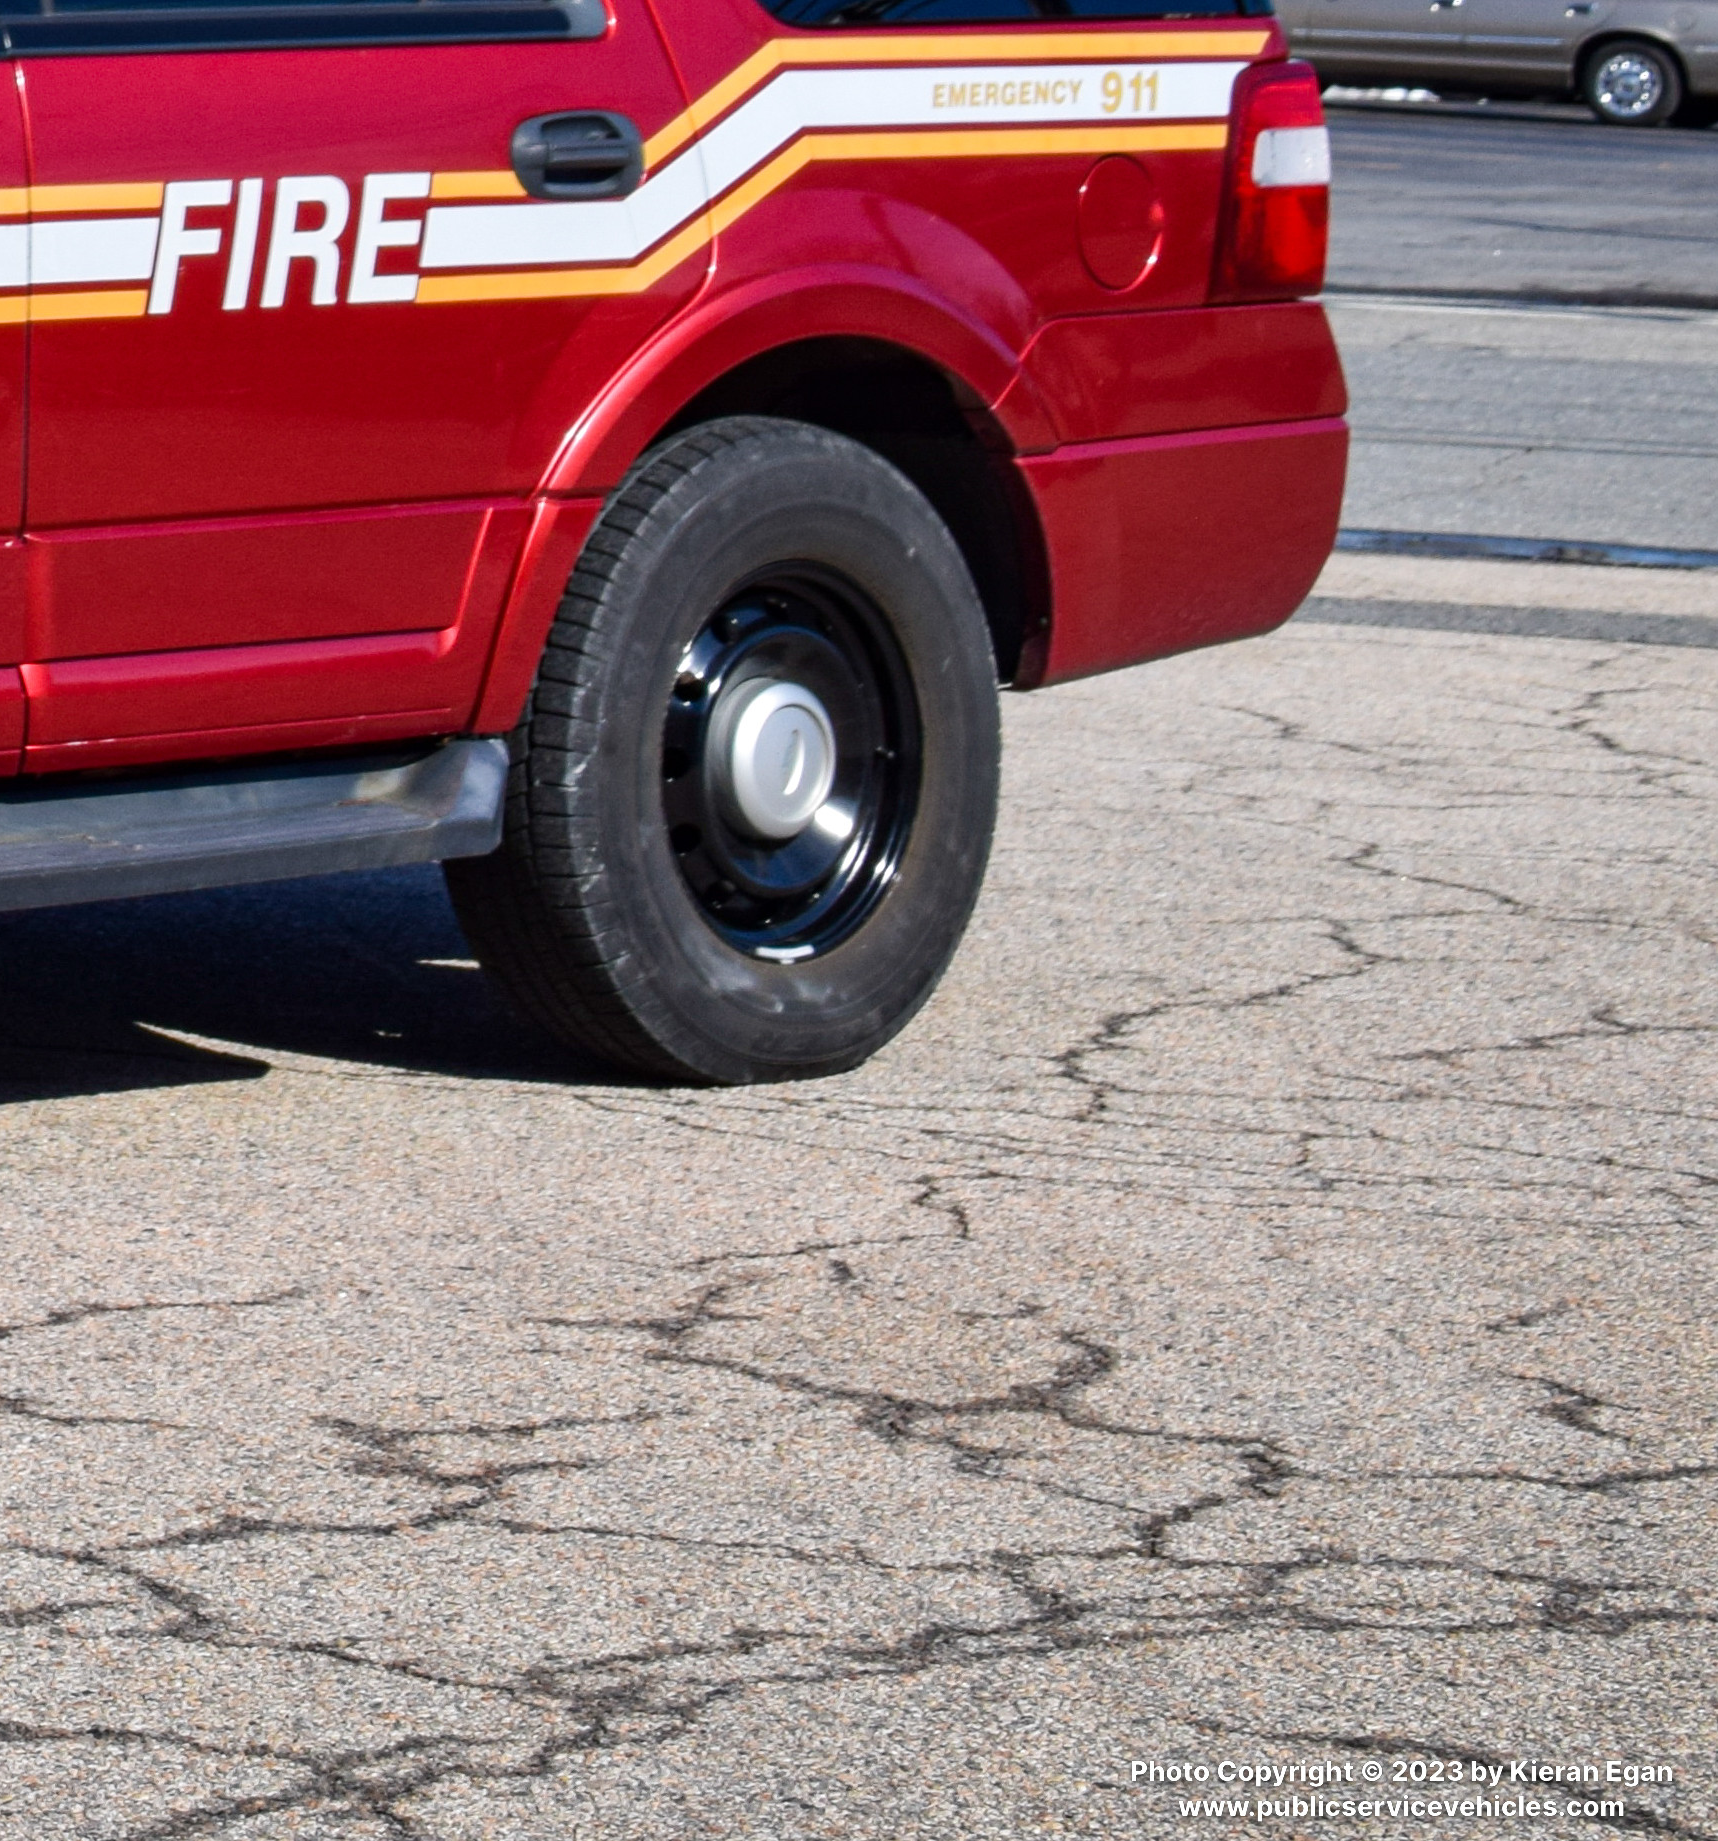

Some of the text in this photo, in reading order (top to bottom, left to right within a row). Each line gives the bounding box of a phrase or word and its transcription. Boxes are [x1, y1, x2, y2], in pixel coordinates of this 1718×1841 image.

[932, 70, 1159, 113] EMERGENCY 911
[147, 171, 432, 315] FIRE
